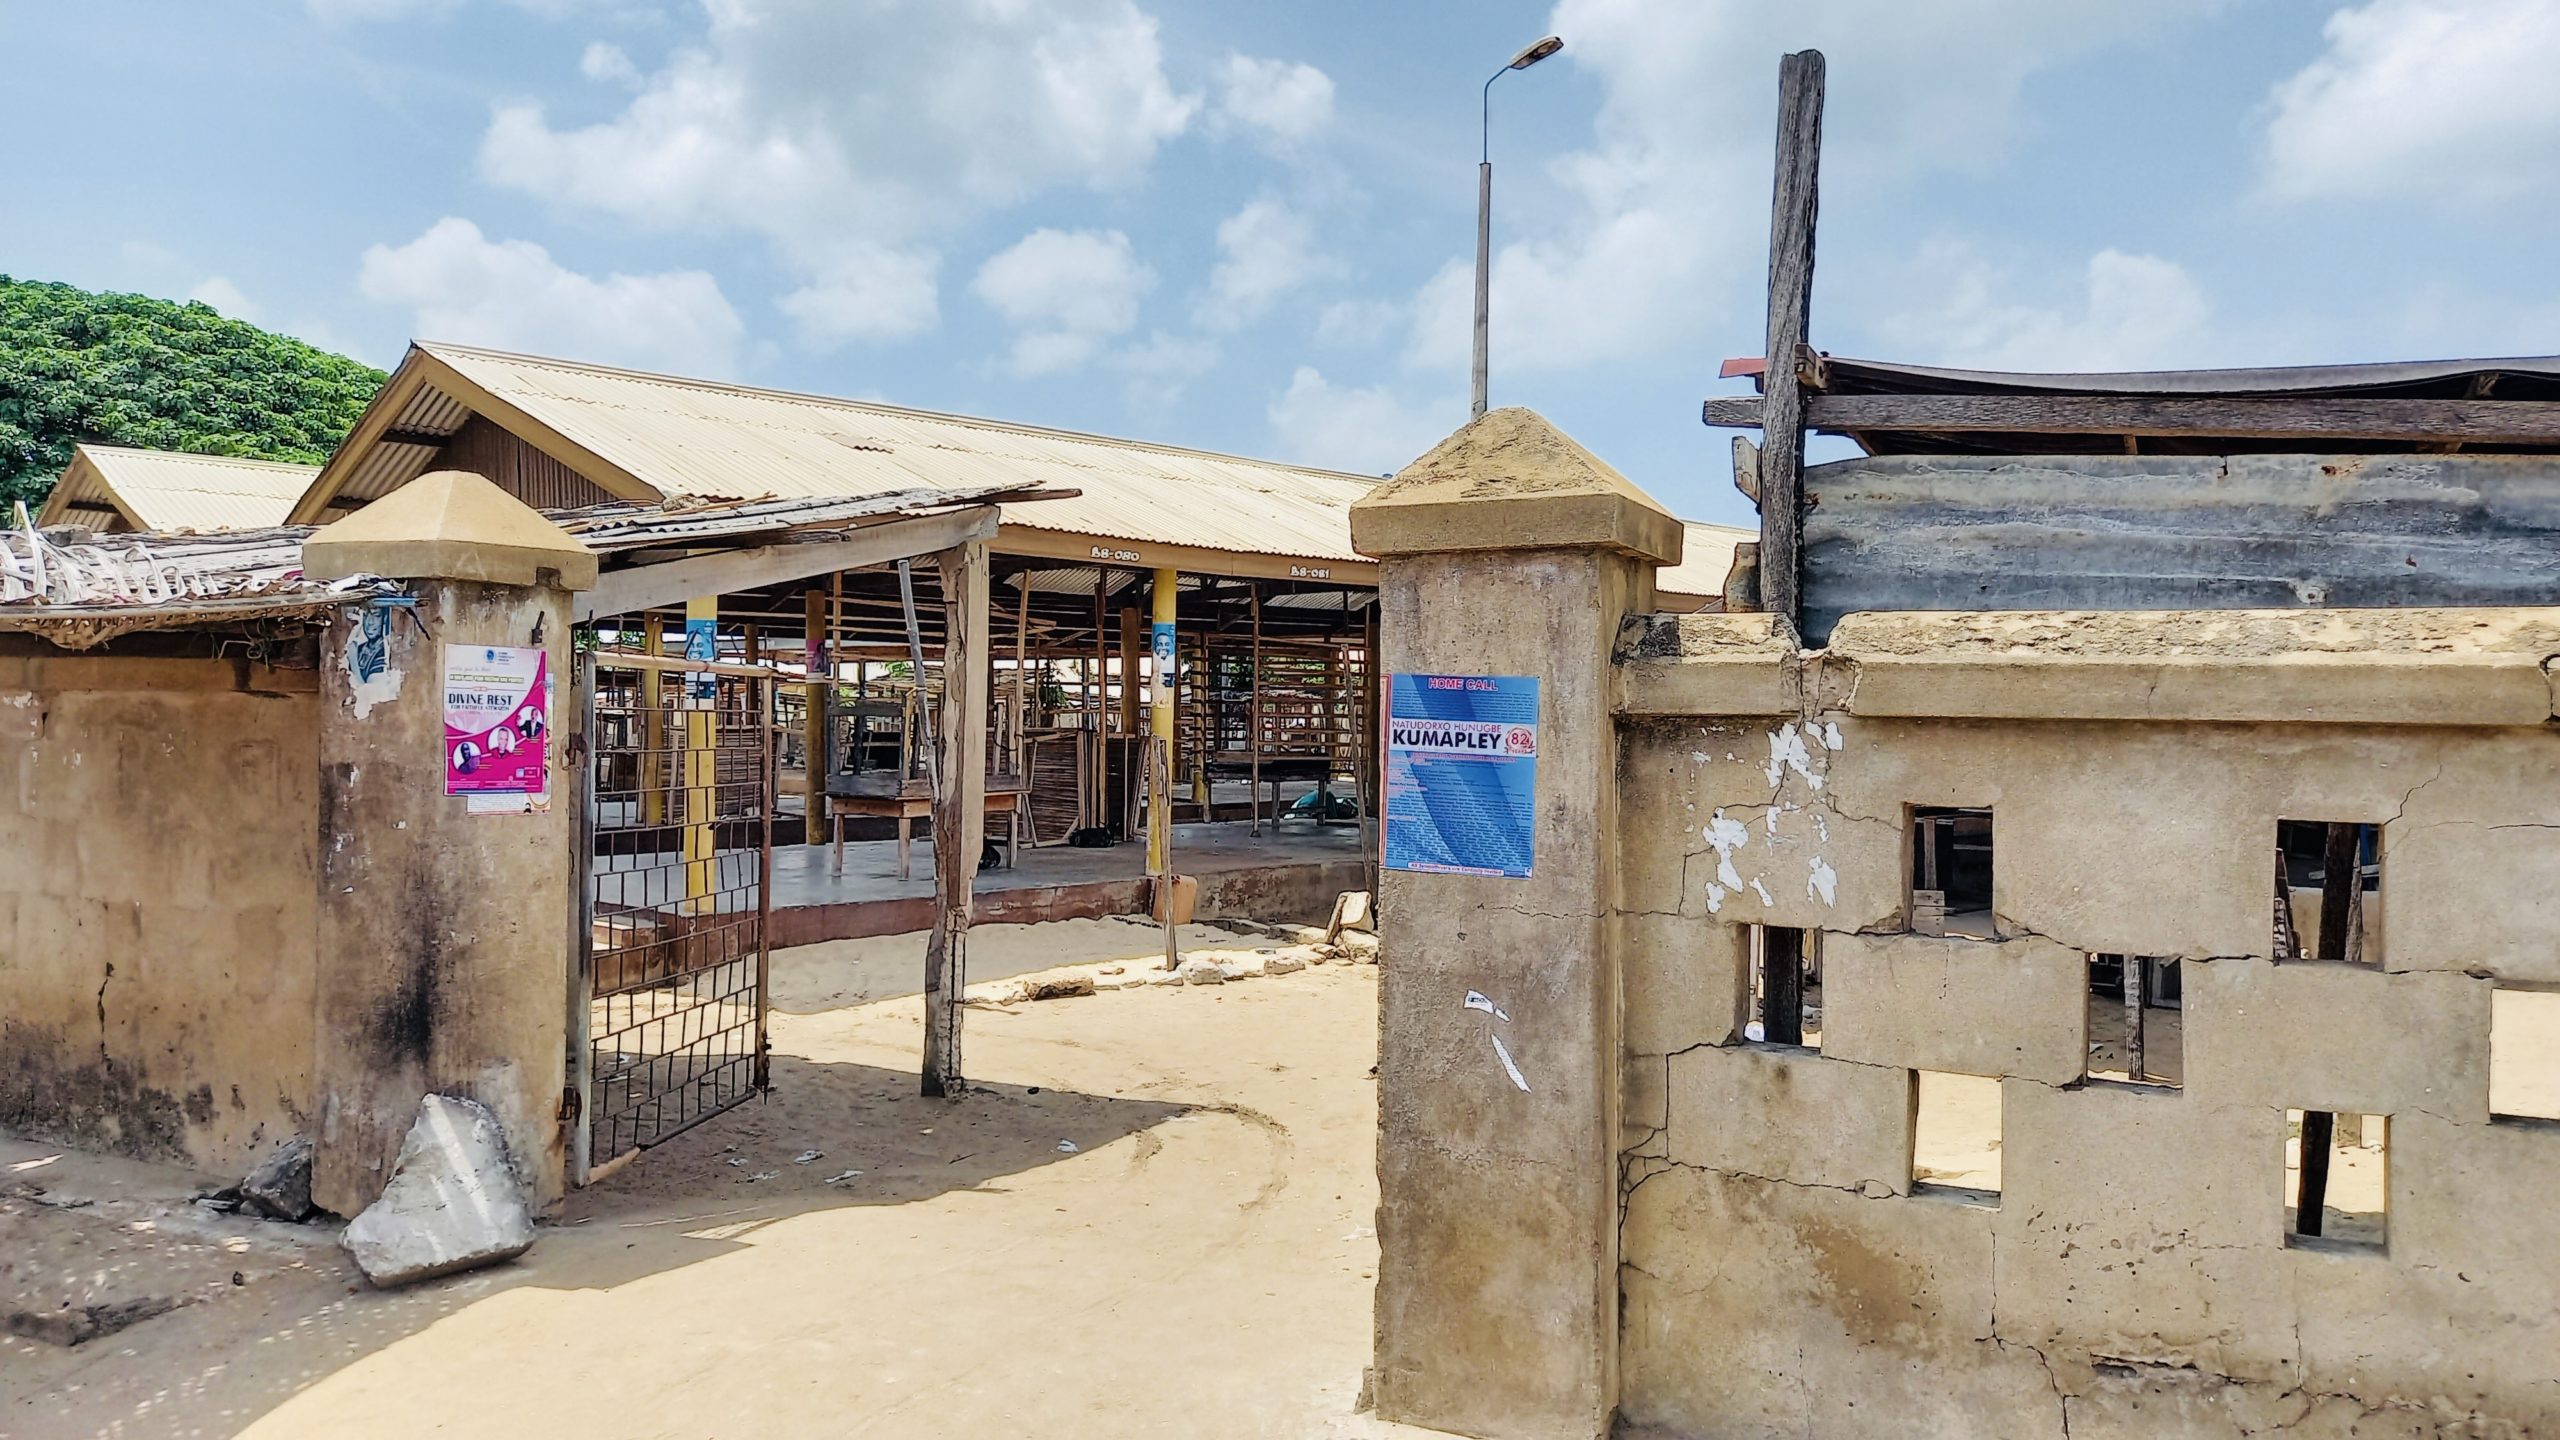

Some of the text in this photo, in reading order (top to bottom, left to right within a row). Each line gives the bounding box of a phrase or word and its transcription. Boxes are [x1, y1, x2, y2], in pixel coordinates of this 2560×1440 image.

[1428, 677, 1498, 691] HOME CALL
[448, 693, 513, 706] DIVINE REST
[1392, 720, 1502, 734] NATUDORXO HUNUGBE
[1393, 729, 1502, 749] KUMAPLEY
[1511, 732, 1527, 745] 82
